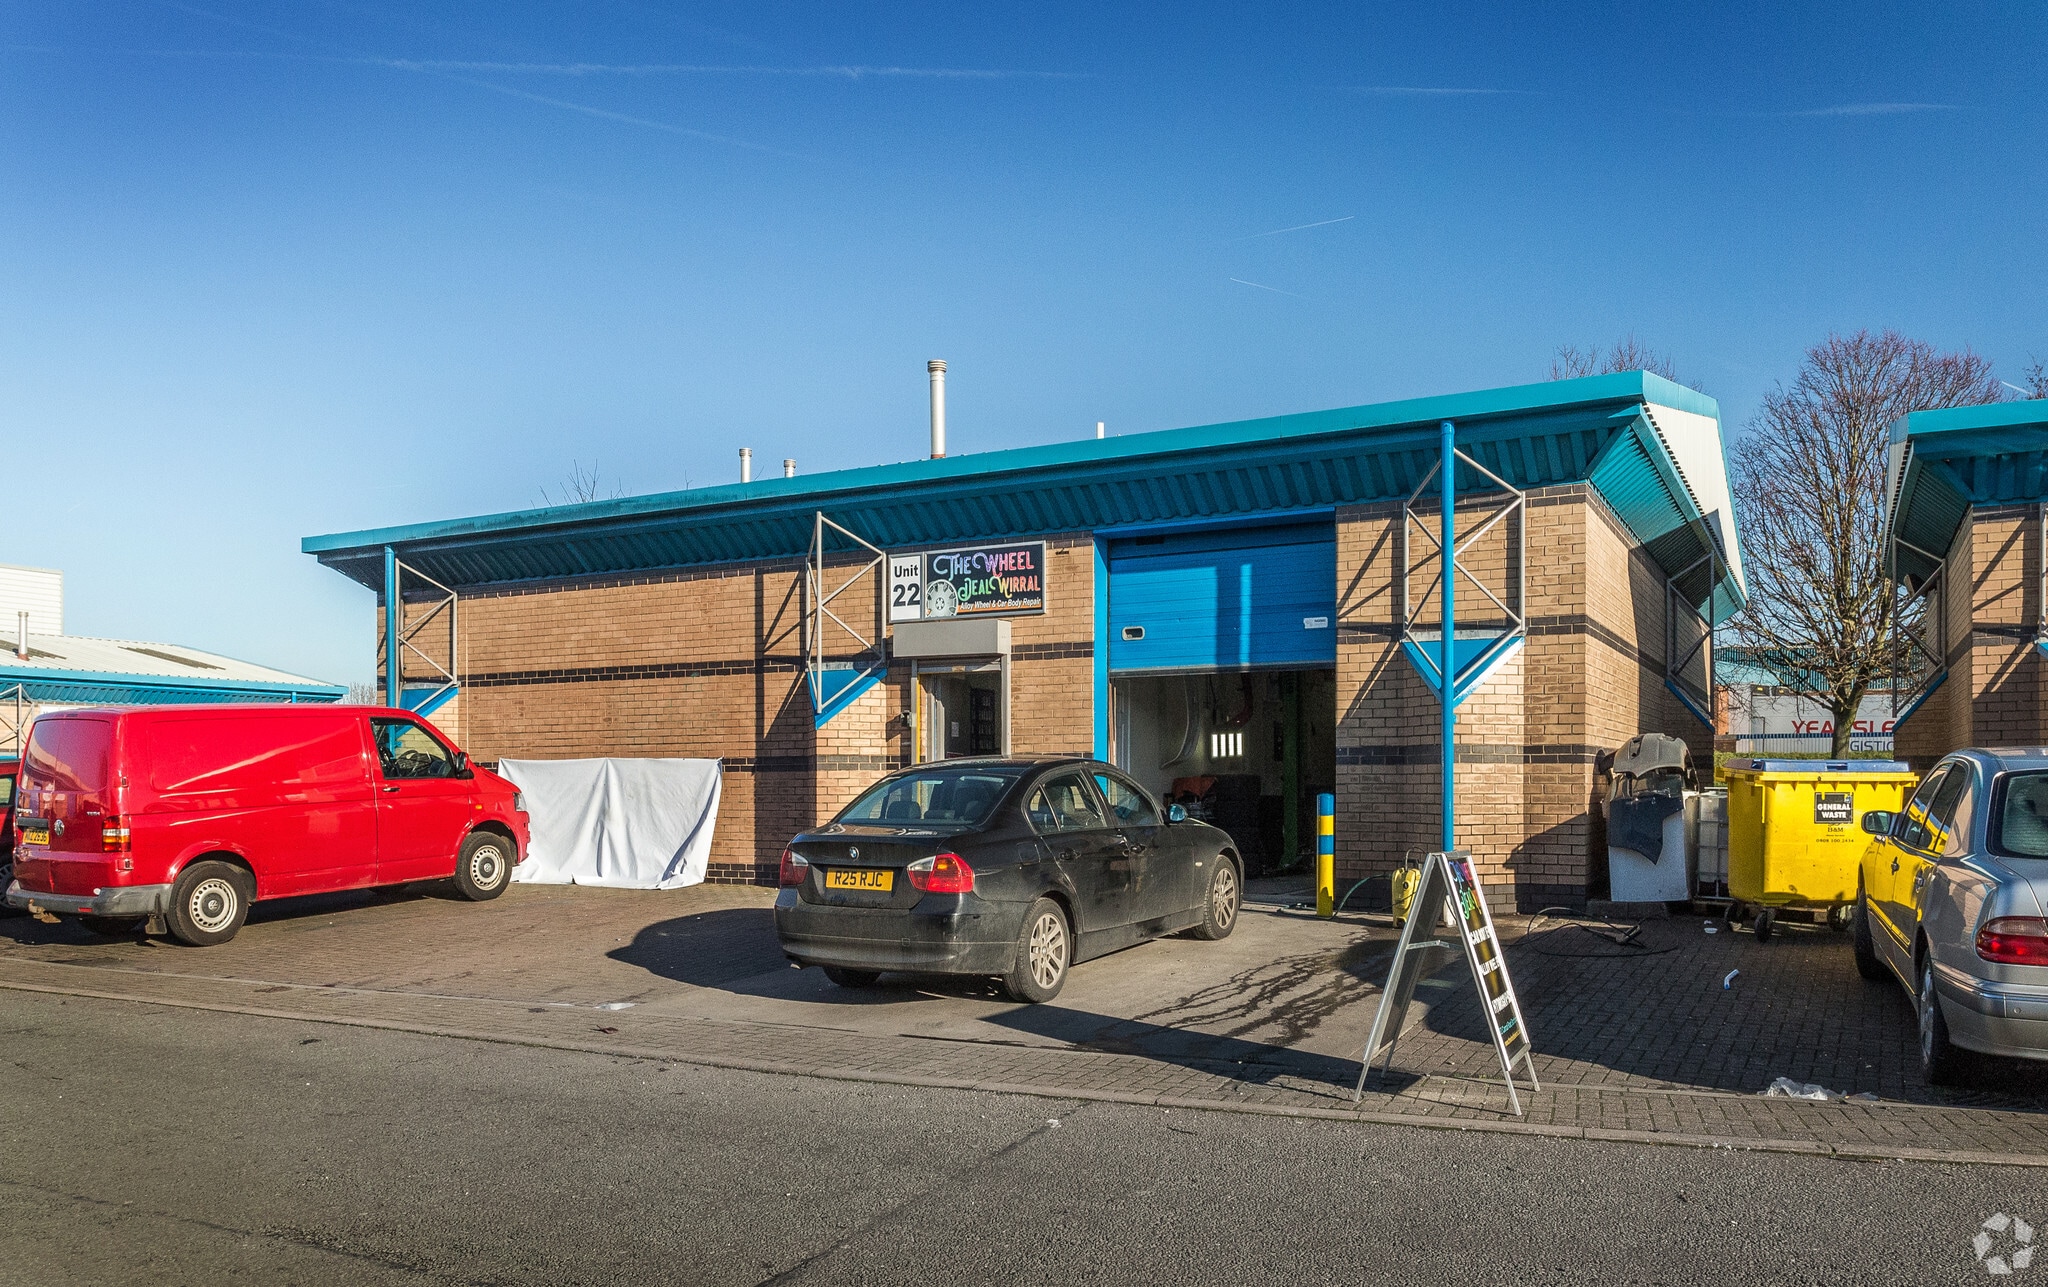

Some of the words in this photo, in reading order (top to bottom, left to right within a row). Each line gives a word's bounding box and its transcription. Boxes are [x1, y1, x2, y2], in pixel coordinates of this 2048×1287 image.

[894, 564, 919, 578] Unit
[933, 553, 972, 581] THE
[972, 551, 1035, 577] WHEEL
[893, 583, 920, 607] 22
[958, 577, 992, 602] DEAL
[989, 575, 1041, 599] WIRRAL
[960, 602, 974, 611] Alloy
[975, 600, 991, 609] Wheel
[992, 600, 997, 608] &
[997, 600, 1007, 608] Car
[1008, 599, 1022, 608] Body
[1023, 597, 1041, 607] Repair
[1817, 803, 1851, 811] GENERAL
[1821, 811, 1847, 819] WASTE
[834, 870, 857, 886] R25
[859, 871, 884, 888] RJC
